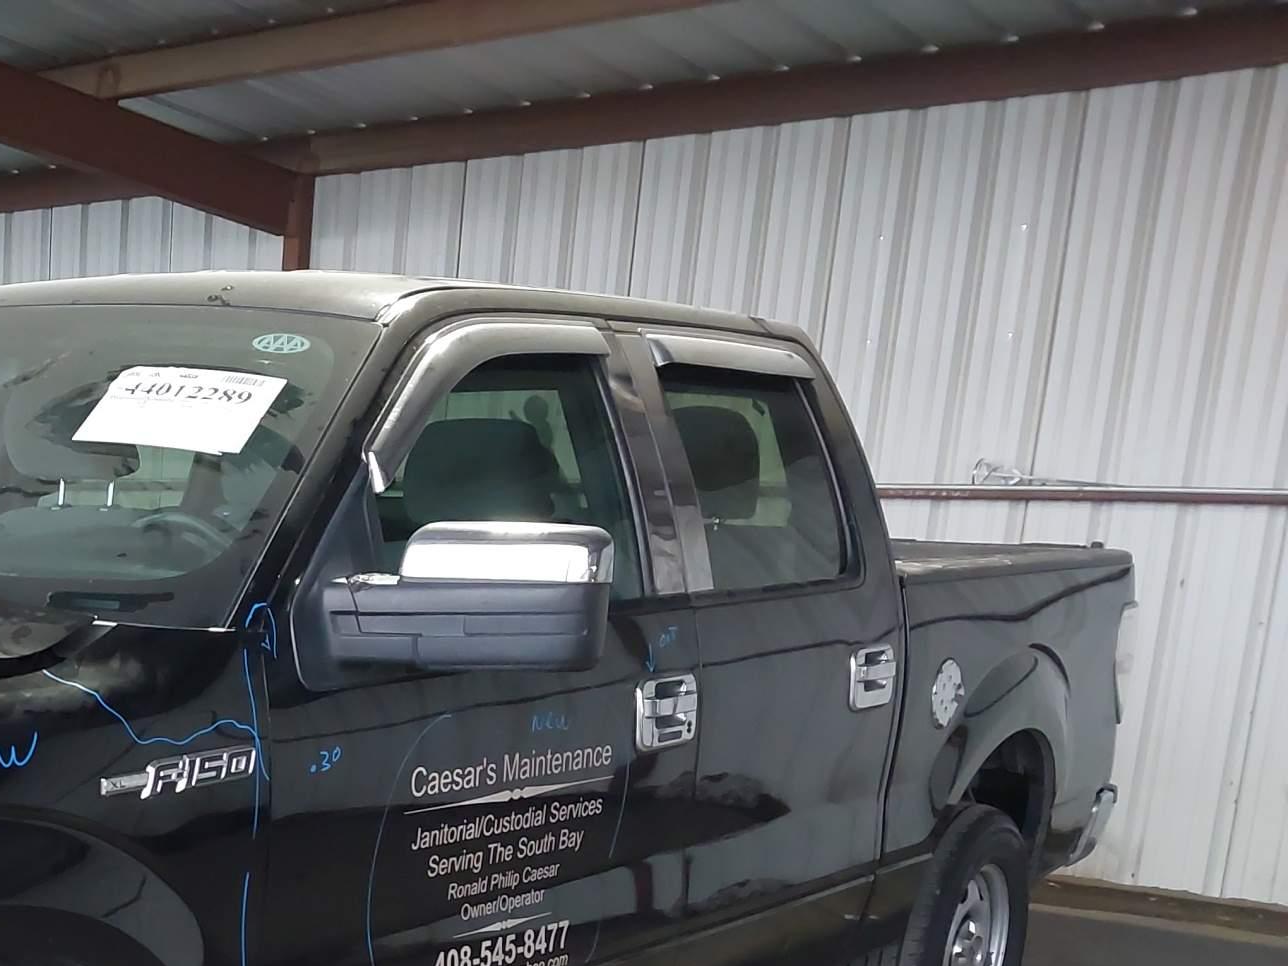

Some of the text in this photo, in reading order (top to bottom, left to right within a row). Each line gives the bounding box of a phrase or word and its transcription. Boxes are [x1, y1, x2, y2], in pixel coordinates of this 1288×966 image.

[124, 382, 253, 405] 44012289
[411, 744, 612, 798] Caesar's Maintenance
[411, 796, 603, 850] Janitorial/Custodial Services
[427, 828, 585, 878] Serving The South Bay
[447, 863, 561, 901] Ronald Philip Caesar
[461, 888, 546, 921] Owner/Operator
